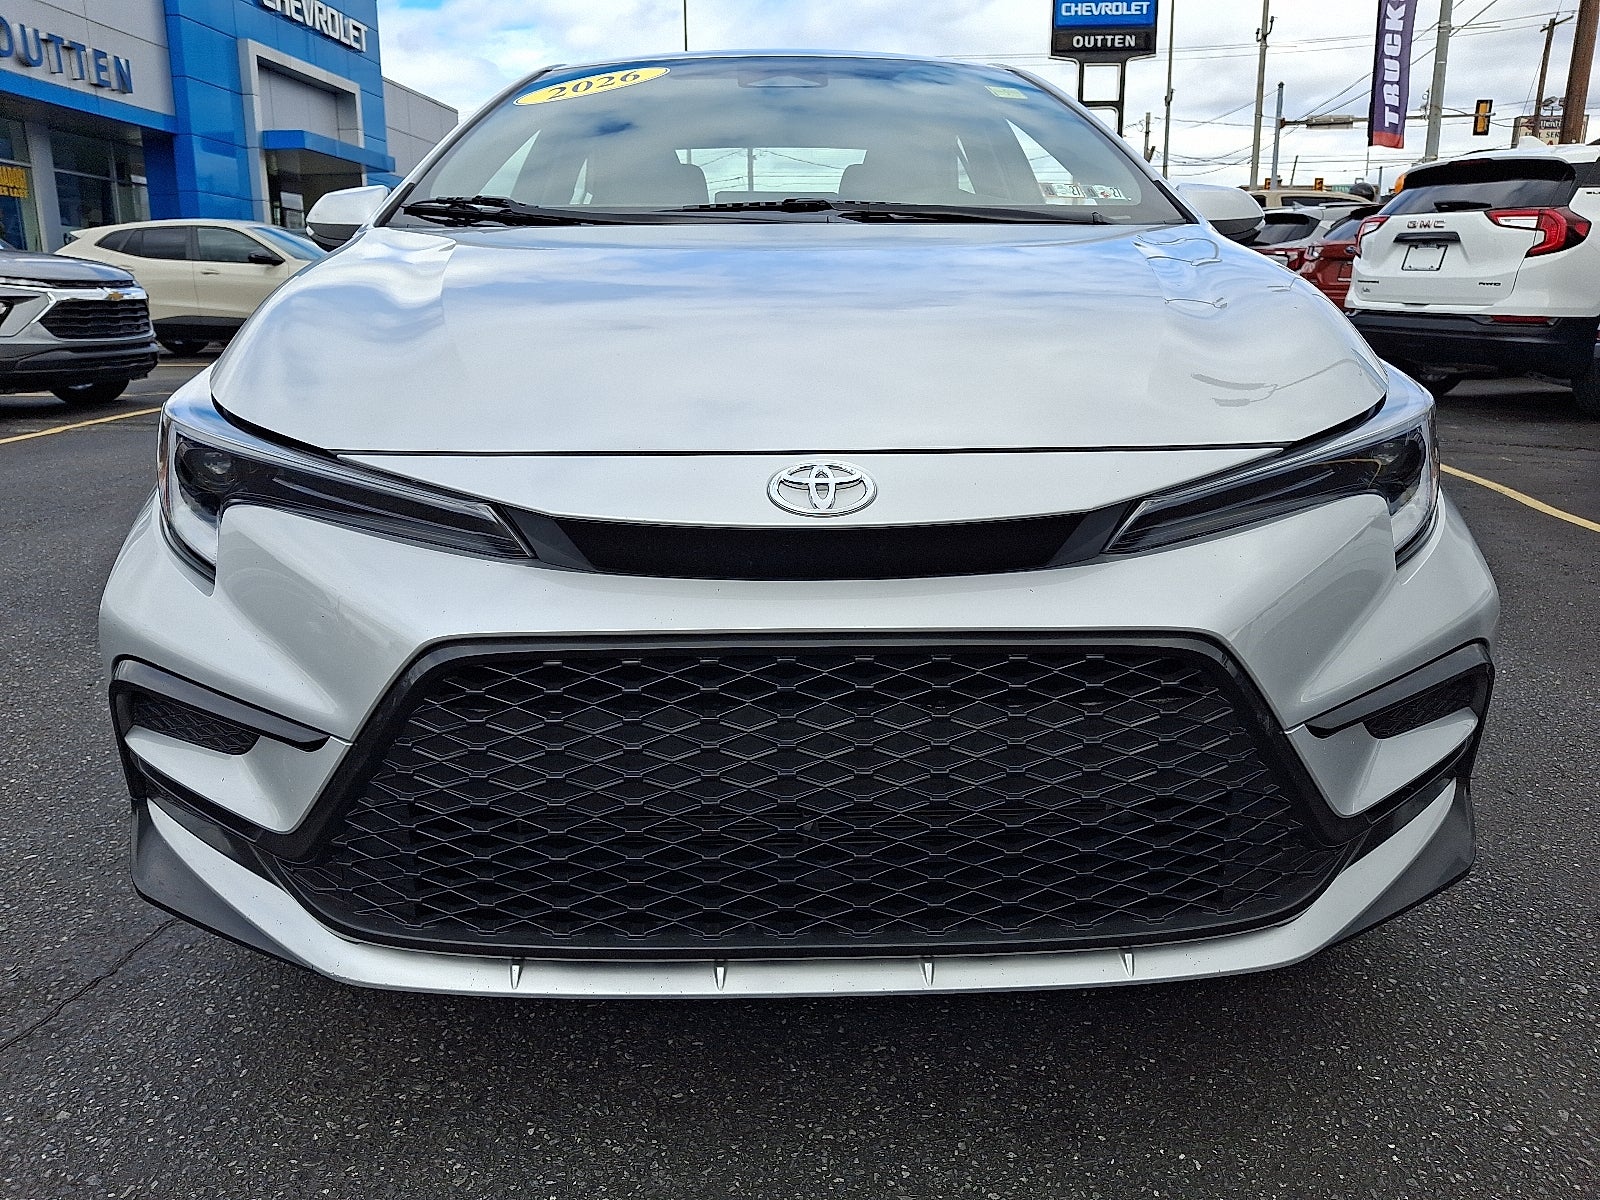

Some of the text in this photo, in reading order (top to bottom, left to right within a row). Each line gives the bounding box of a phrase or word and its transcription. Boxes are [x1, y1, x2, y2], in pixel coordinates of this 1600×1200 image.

[1060, 1, 1150, 16] CHEVROLET
[1072, 34, 1136, 48] OUTTEN
[1382, 0, 1406, 127] TRUCK
[548, 70, 640, 100] 2026
[1407, 219, 1446, 229] GMC
